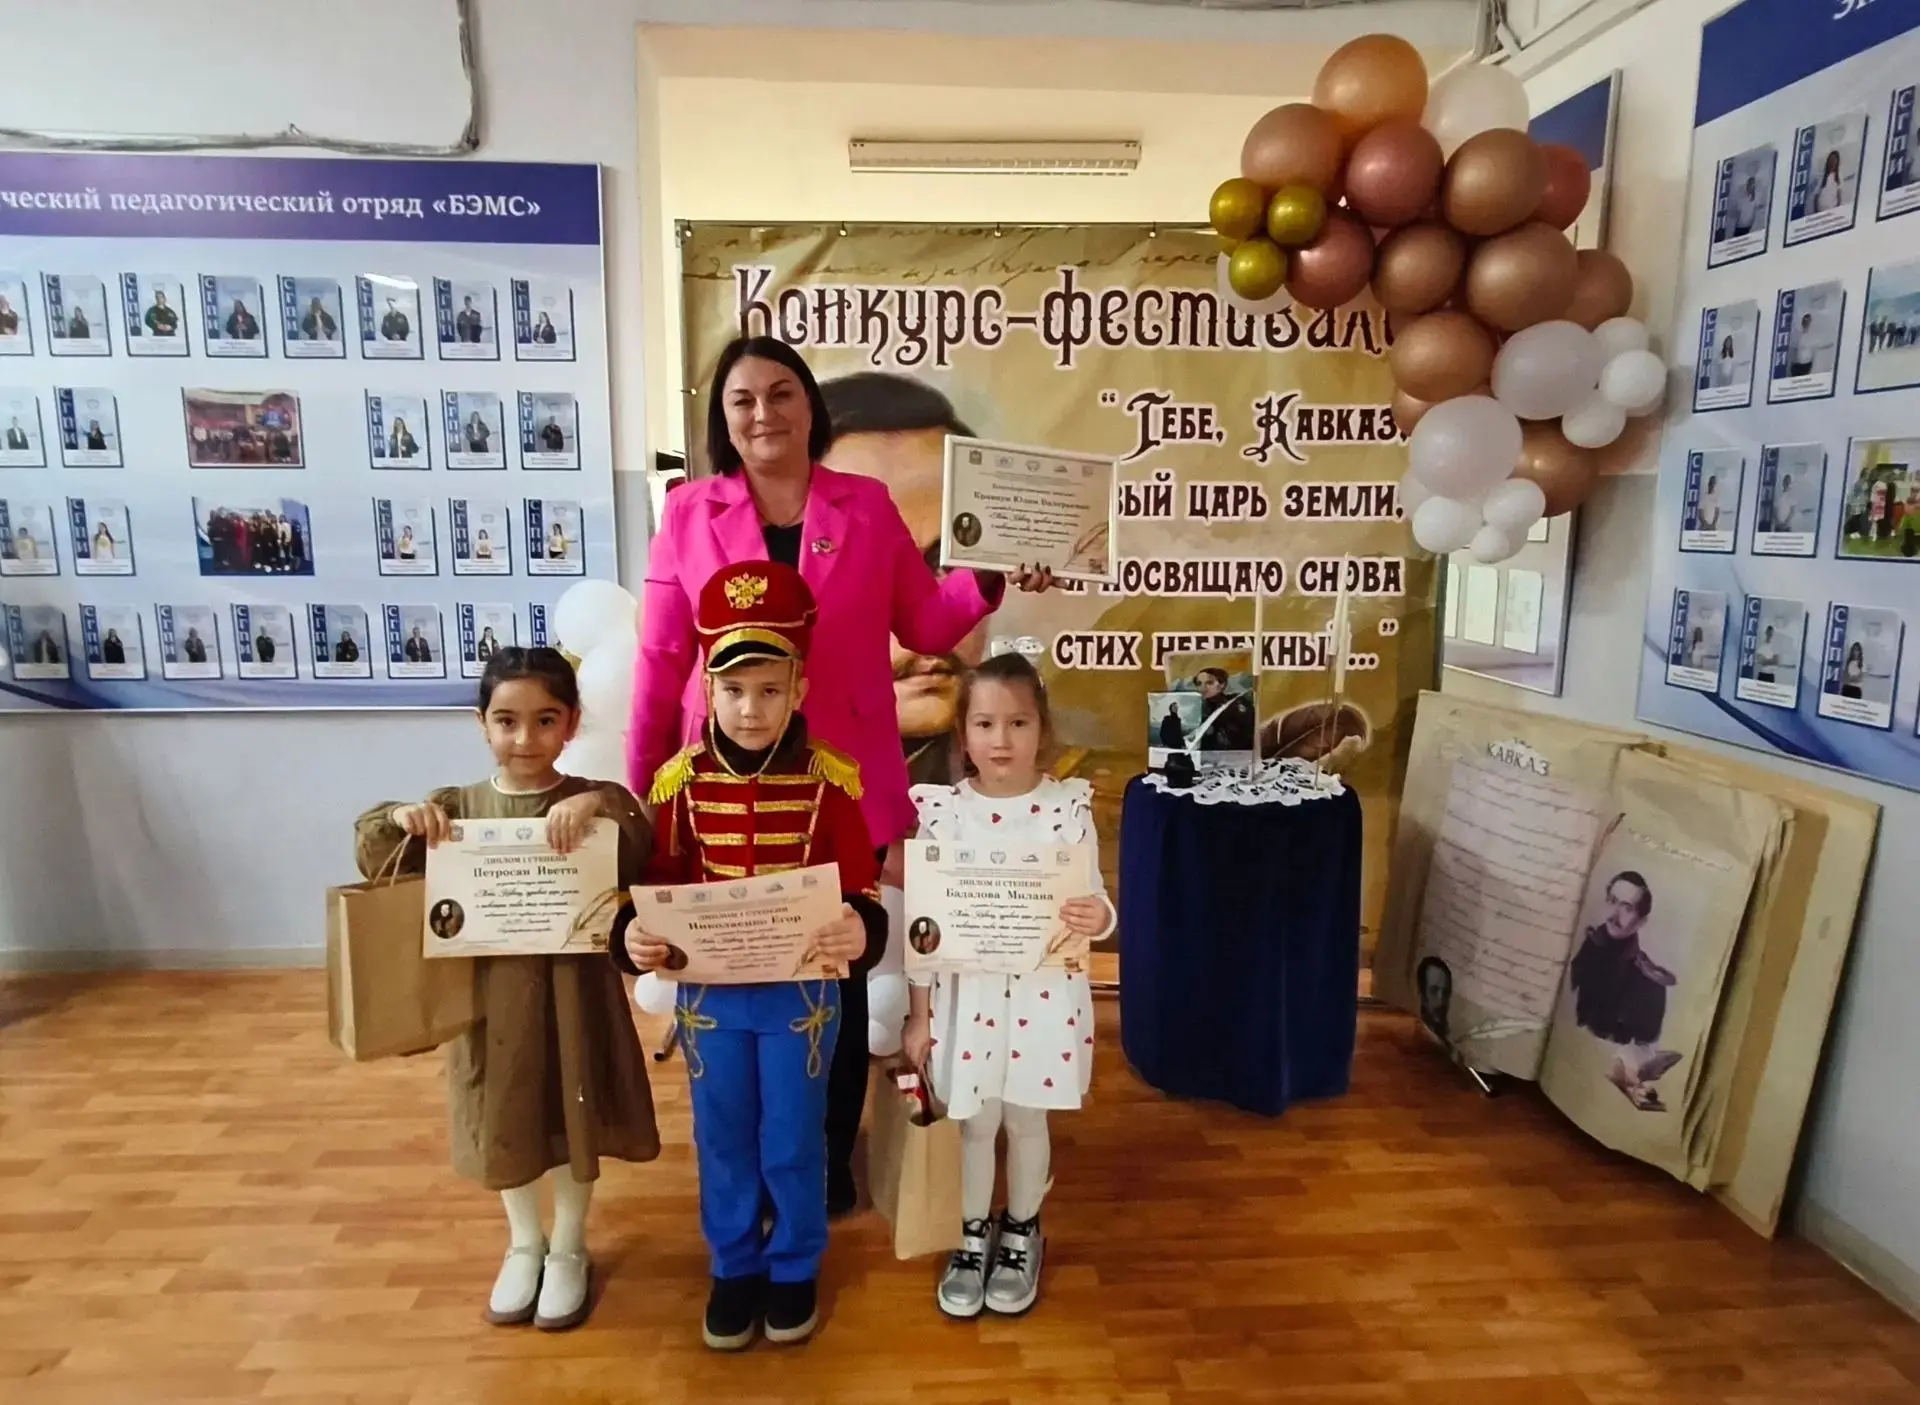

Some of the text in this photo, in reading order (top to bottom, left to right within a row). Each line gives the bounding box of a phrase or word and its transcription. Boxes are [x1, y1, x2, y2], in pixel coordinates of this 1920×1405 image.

[110, 190, 334, 215] педагогический
[342, 196, 424, 219] отряд
[432, 194, 541, 216] «БЭМС»
[736, 268, 1395, 367] Конкурс-фестивал
[1189, 484, 1268, 522] ЦАРЬ
[1056, 634, 1138, 666] СТИХ
